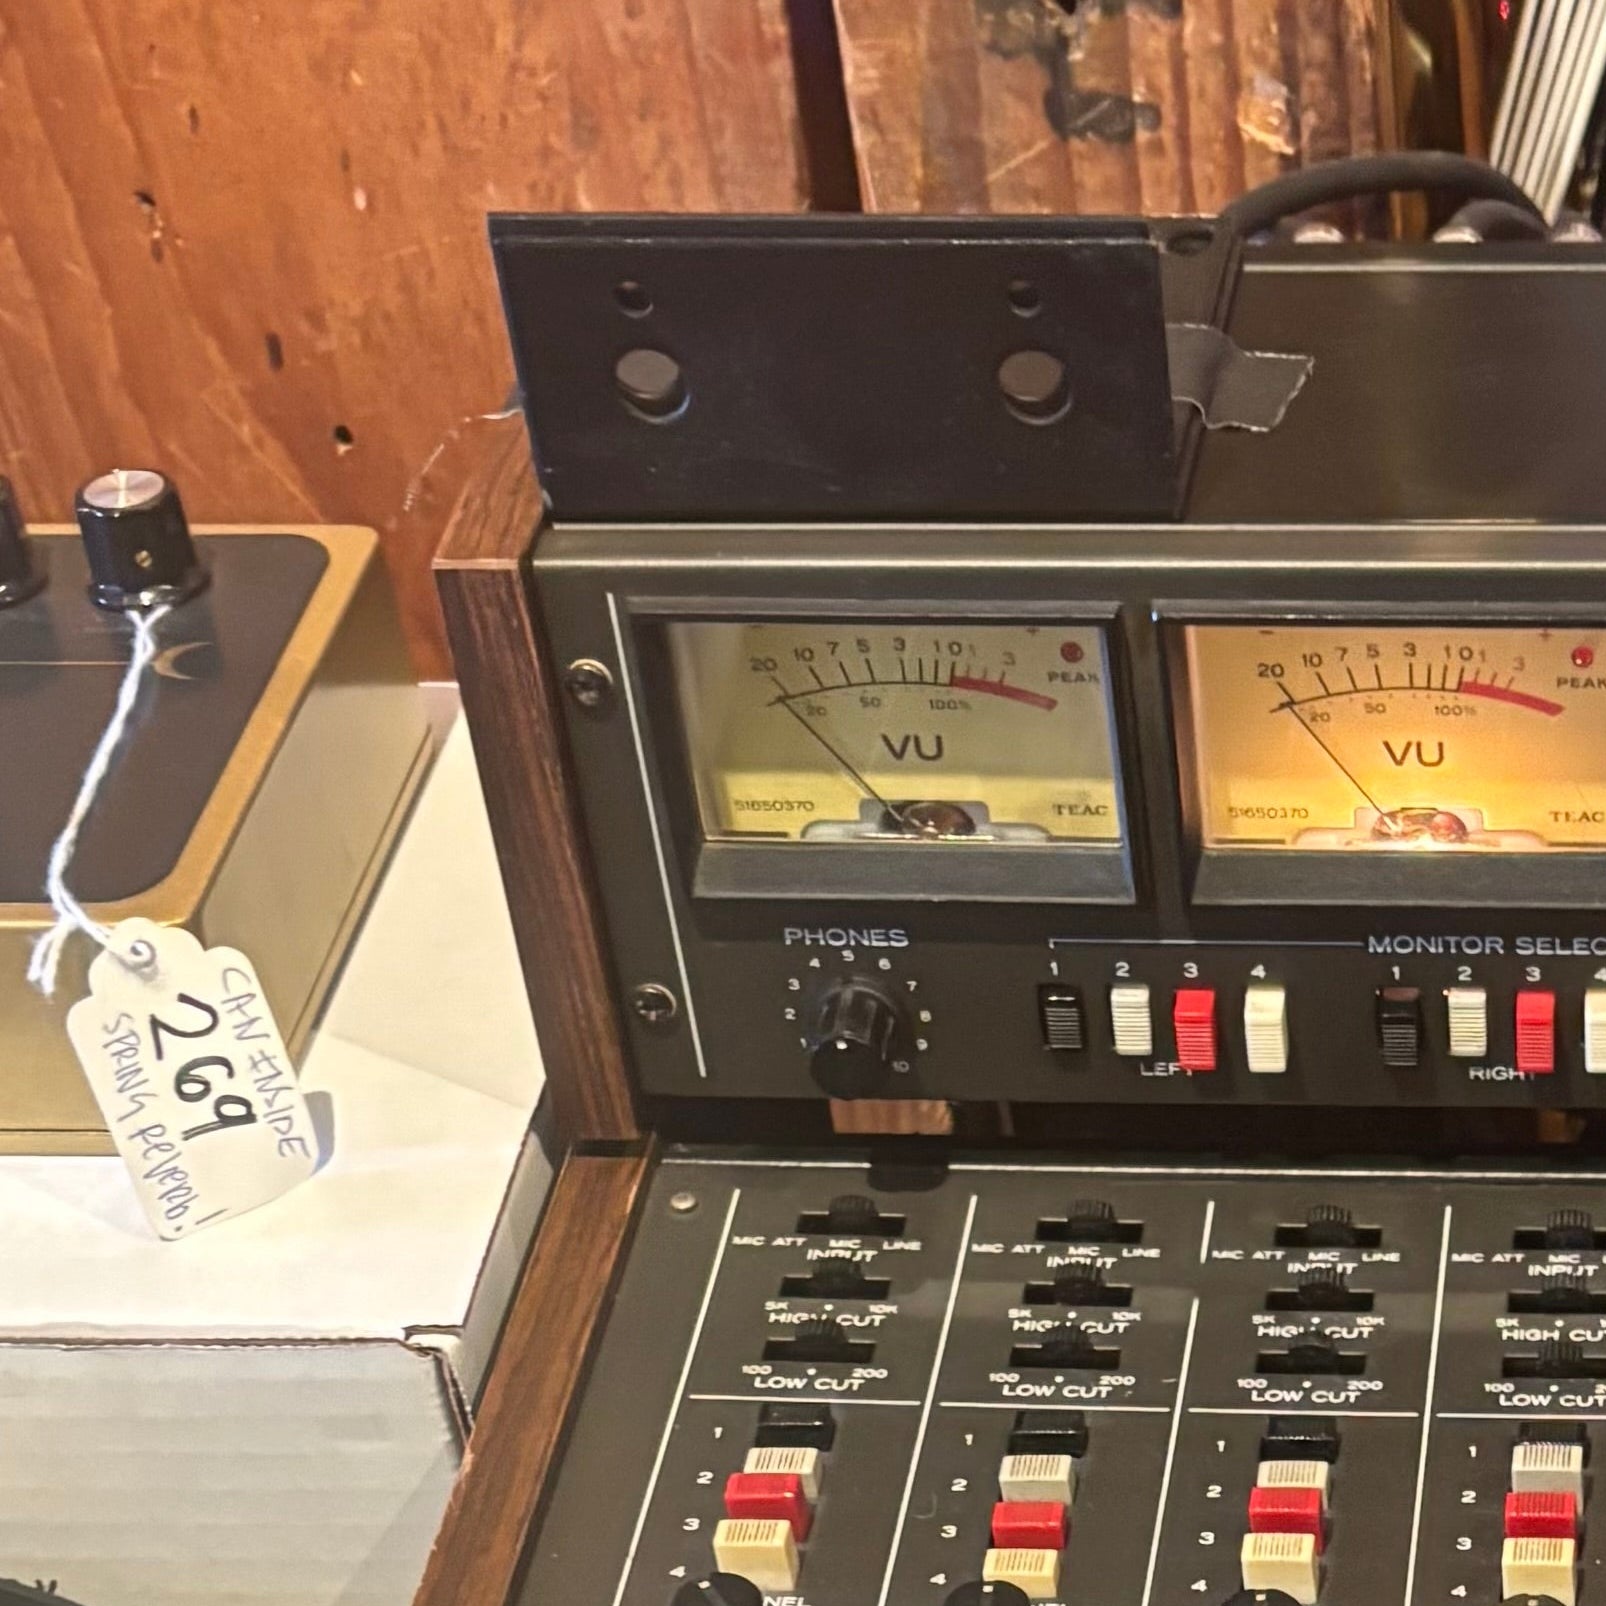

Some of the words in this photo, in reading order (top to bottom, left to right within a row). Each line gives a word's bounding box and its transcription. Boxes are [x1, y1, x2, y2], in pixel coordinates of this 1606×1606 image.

[1257, 663, 1286, 679] 20
[1302, 652, 1323, 669] 10
[1336, 647, 1348, 662] 7
[1366, 643, 1381, 659] 5
[1403, 642, 1418, 658] 3
[1364, 702, 1386, 715] 50
[881, 734, 945, 761] VU
[1381, 739, 1445, 768] VU
[1053, 804, 1109, 817] TEAC
[1548, 810, 1606, 823] TEAC
[784, 928, 908, 948] PHONES
[1368, 935, 1504, 956] MONITOR
[842, 950, 854, 962] 5
[809, 958, 820, 968] 4
[879, 959, 891, 969] 6
[1050, 962, 1059, 975] 1
[1115, 962, 1131, 977] 2
[1183, 963, 1198, 977] 3
[1250, 964, 1267, 979] 4
[1391, 967, 1400, 980] 1
[1458, 967, 1472, 981] 2
[1526, 967, 1540, 982] 3
[788, 979, 800, 990] 3
[907, 981, 918, 992] 7
[221, 967, 270, 1041] CAN
[149, 992, 258, 1142] 269
[1140, 1062, 1194, 1078] LEF
[732, 1235, 764, 1247] MIC
[771, 1236, 807, 1247] ATT
[829, 1239, 862, 1249] MIC
[883, 1240, 922, 1251] LINE
[1451, 1253, 1484, 1263] MIC
[1491, 1253, 1525, 1263] ATT
[1548, 1253, 1581, 1264] MIC
[1528, 1264, 1598, 1277] INPUT
[1502, 1329, 1559, 1341] HIGH
[742, 1365, 772, 1375] 100
[852, 1368, 887, 1379] 200
[989, 1372, 1019, 1382] 100
[1100, 1375, 1136, 1385] 200
[754, 1376, 808, 1390] LOW
[813, 1378, 865, 1391] CUT
[1237, 1379, 1268, 1389] 100
[1347, 1380, 1383, 1390] 200
[1484, 1383, 1514, 1393] 100
[1001, 1384, 1055, 1397] LOW
[1061, 1385, 1113, 1398] CUT
[1251, 1390, 1304, 1402] LOW
[1310, 1390, 1361, 1403] CUT
[1499, 1394, 1551, 1407] LOW
[715, 1427, 723, 1439] 1
[697, 1472, 714, 1484] 2
[682, 1518, 700, 1531] 3
[669, 1566, 687, 1577] 4
